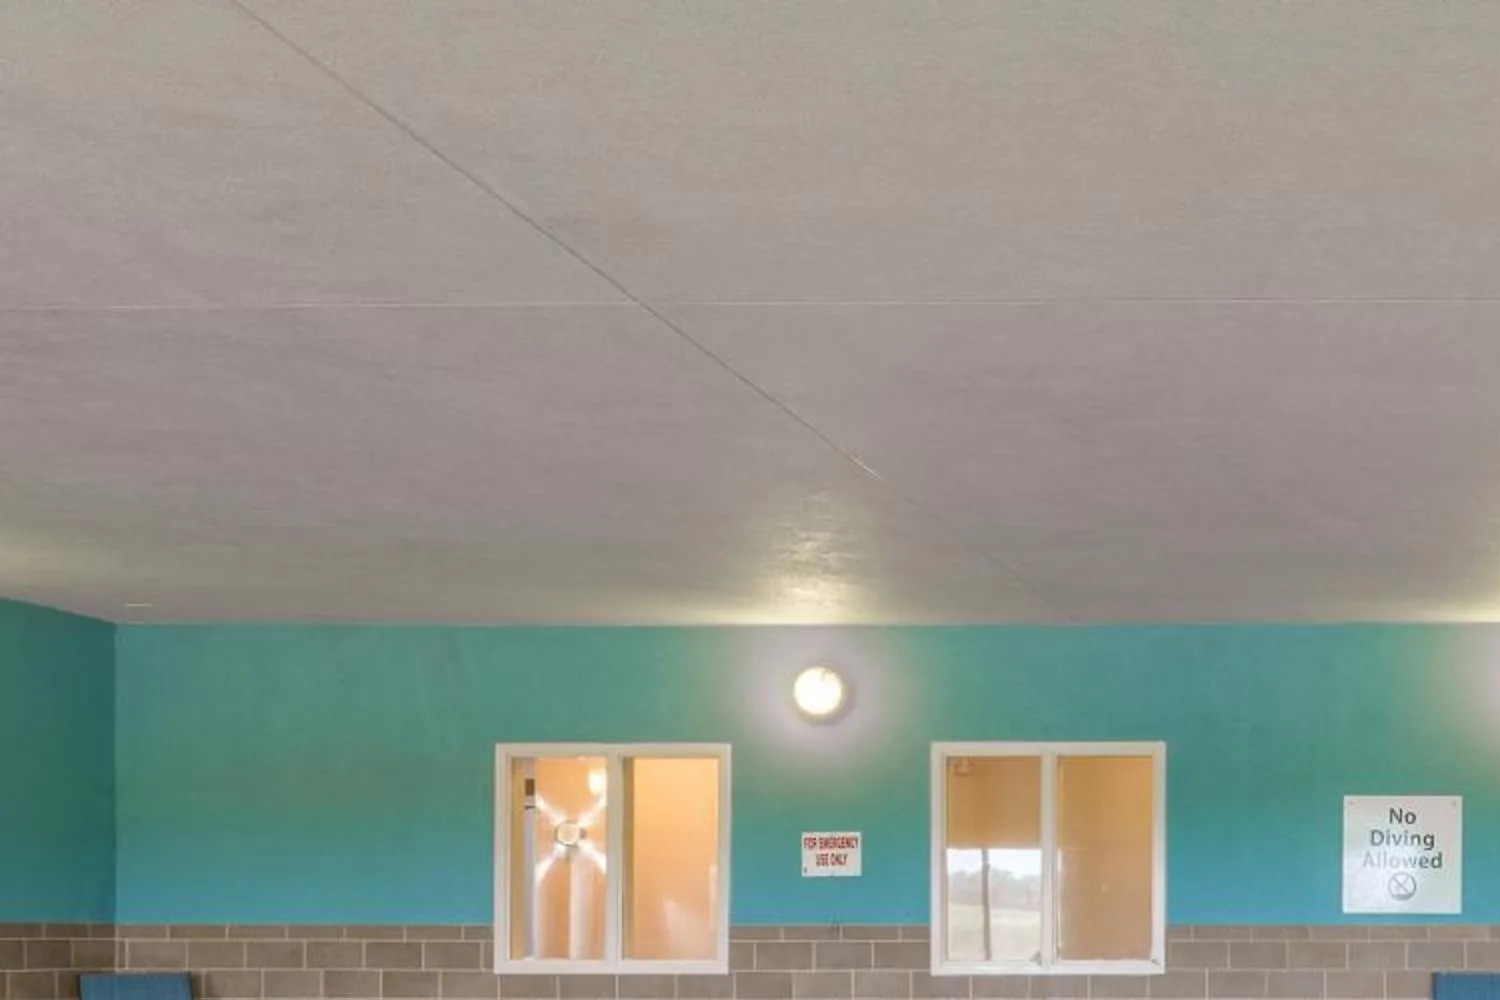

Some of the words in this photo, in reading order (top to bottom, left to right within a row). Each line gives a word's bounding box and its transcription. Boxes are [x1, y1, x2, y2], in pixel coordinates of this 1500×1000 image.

[1389, 807, 1417, 825] No
[1369, 829, 1435, 851] Diving
[1362, 852, 1443, 869] Allowed
